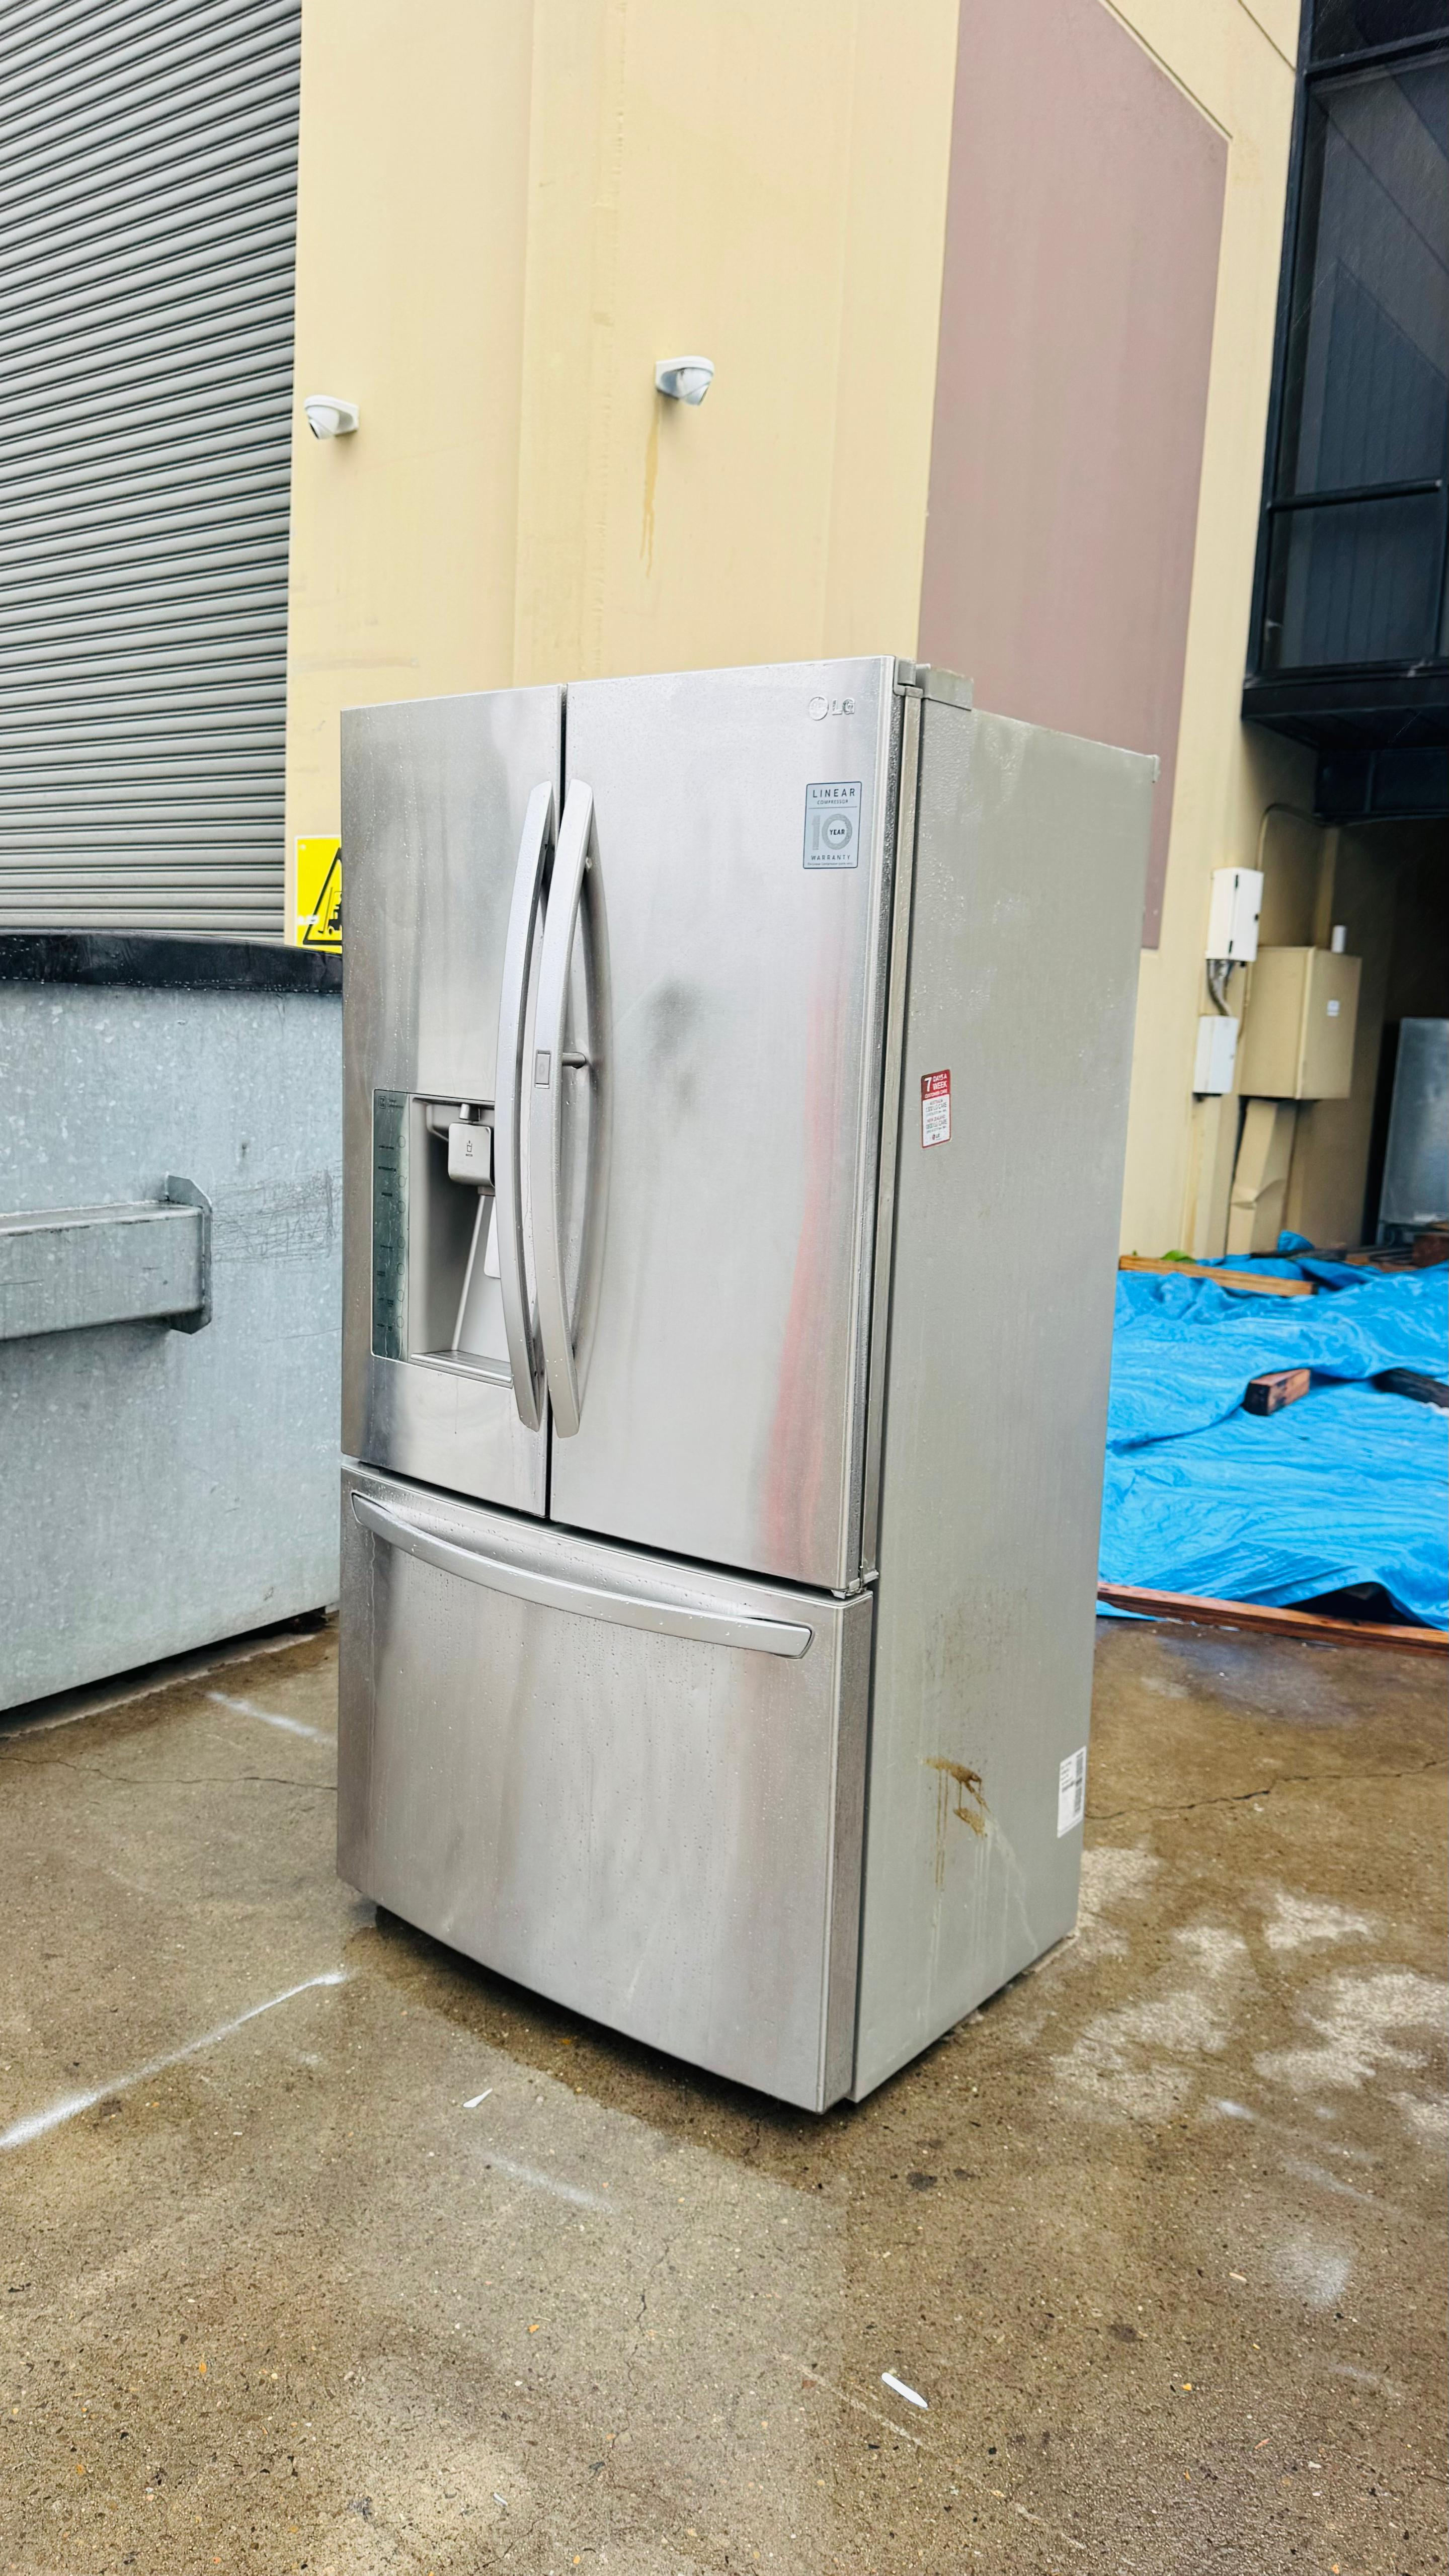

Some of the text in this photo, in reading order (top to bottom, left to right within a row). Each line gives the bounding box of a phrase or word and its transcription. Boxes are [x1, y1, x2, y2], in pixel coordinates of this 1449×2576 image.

[832, 698, 855, 715] LG
[813, 788, 855, 798] LINEAR
[812, 814, 853, 850] 10
[924, 1077, 932, 1092] 7
